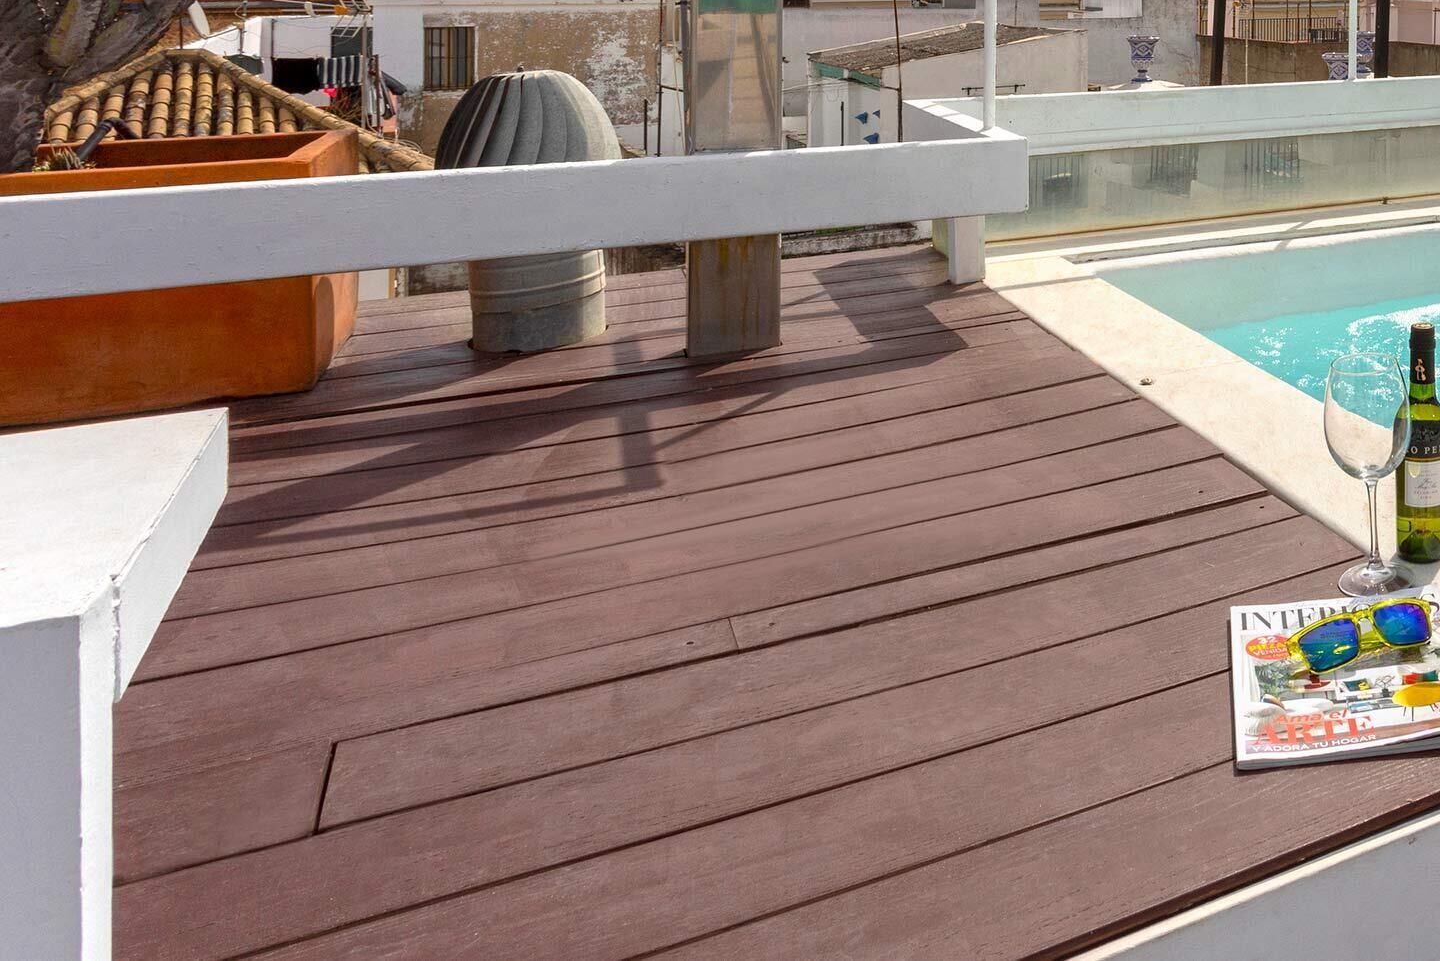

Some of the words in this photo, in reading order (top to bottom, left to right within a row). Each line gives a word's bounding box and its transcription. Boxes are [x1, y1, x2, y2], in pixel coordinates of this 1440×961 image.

[1274, 713, 1323, 724] Ama
[1329, 708, 1348, 720] el
[1252, 714, 1377, 746] ARTE
[1252, 745, 1262, 753] Y
[1264, 744, 1310, 753] ADORA
[1314, 740, 1329, 749] TU
[1330, 733, 1377, 745] HOGAR
